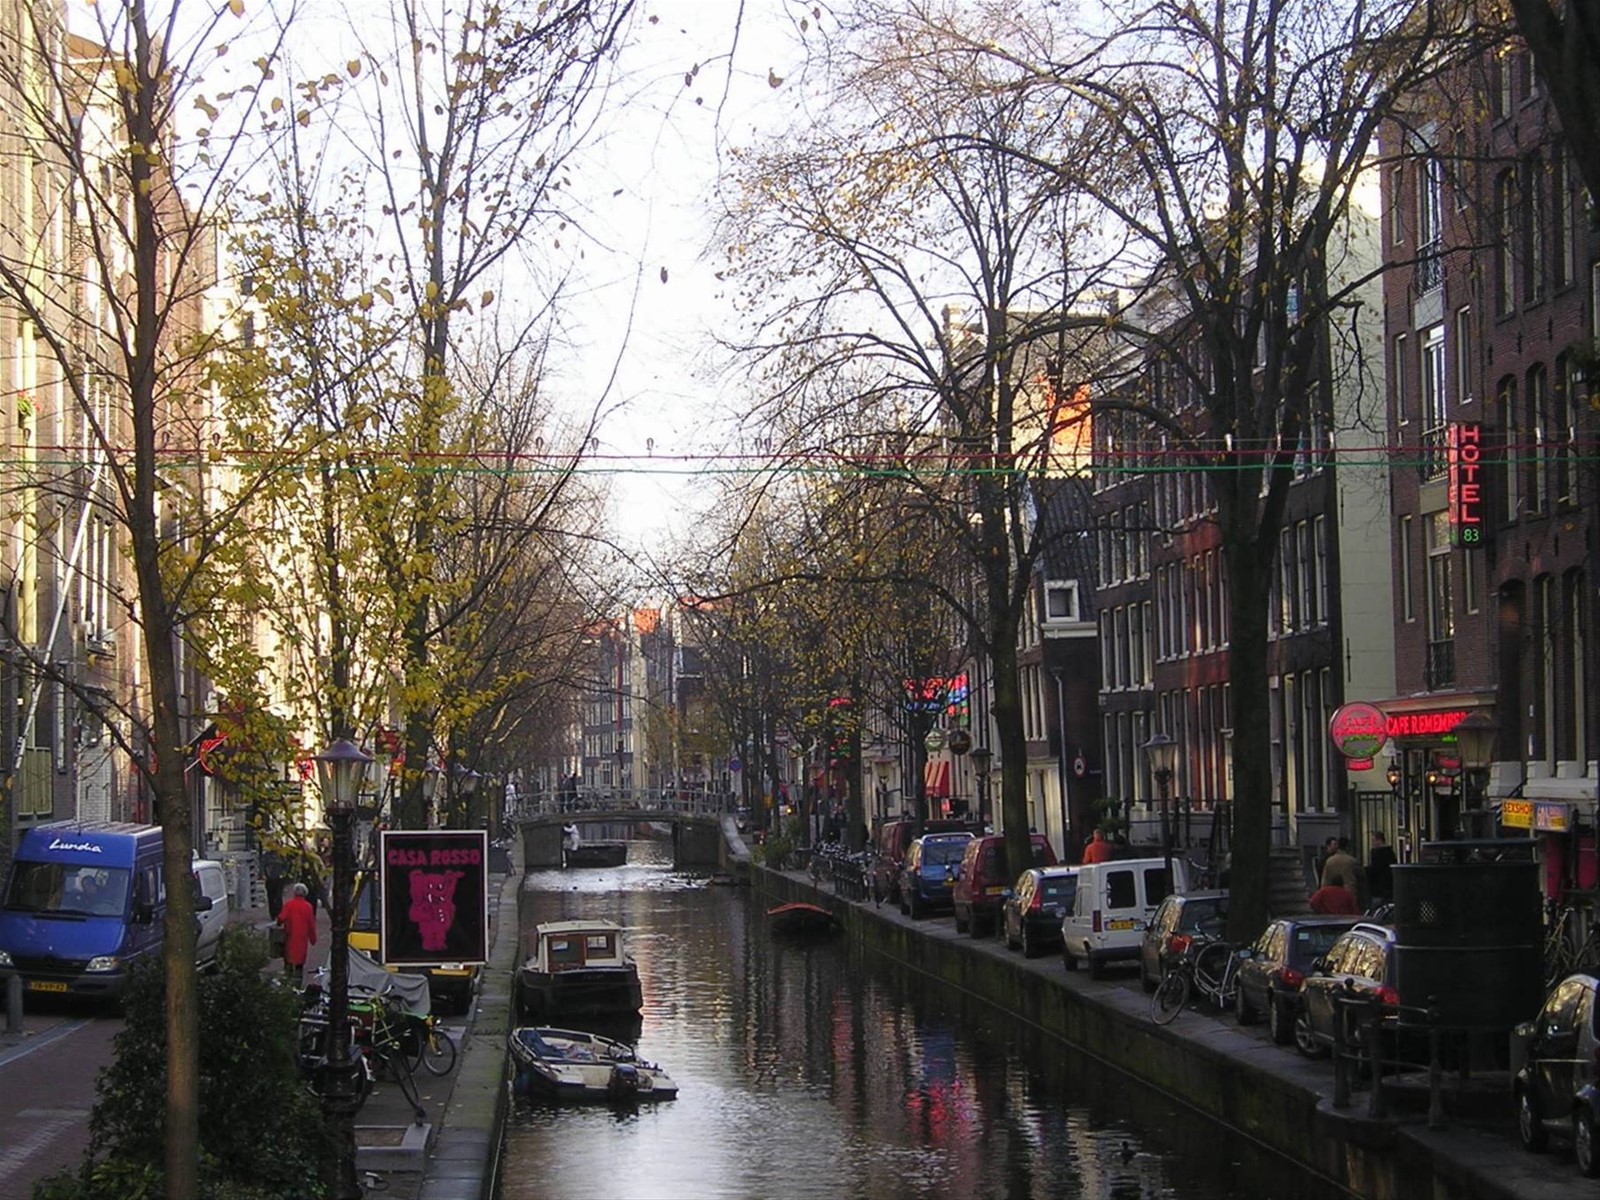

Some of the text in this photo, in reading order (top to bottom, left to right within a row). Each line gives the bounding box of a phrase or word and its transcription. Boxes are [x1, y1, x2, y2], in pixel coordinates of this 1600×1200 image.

[1460, 424, 1480, 522] HOTEL
[1463, 528, 1479, 542] 83
[1386, 715, 1410, 736] CAFE
[49, 839, 103, 853] Lundia
[387, 849, 481, 866] CASA ROSSO
